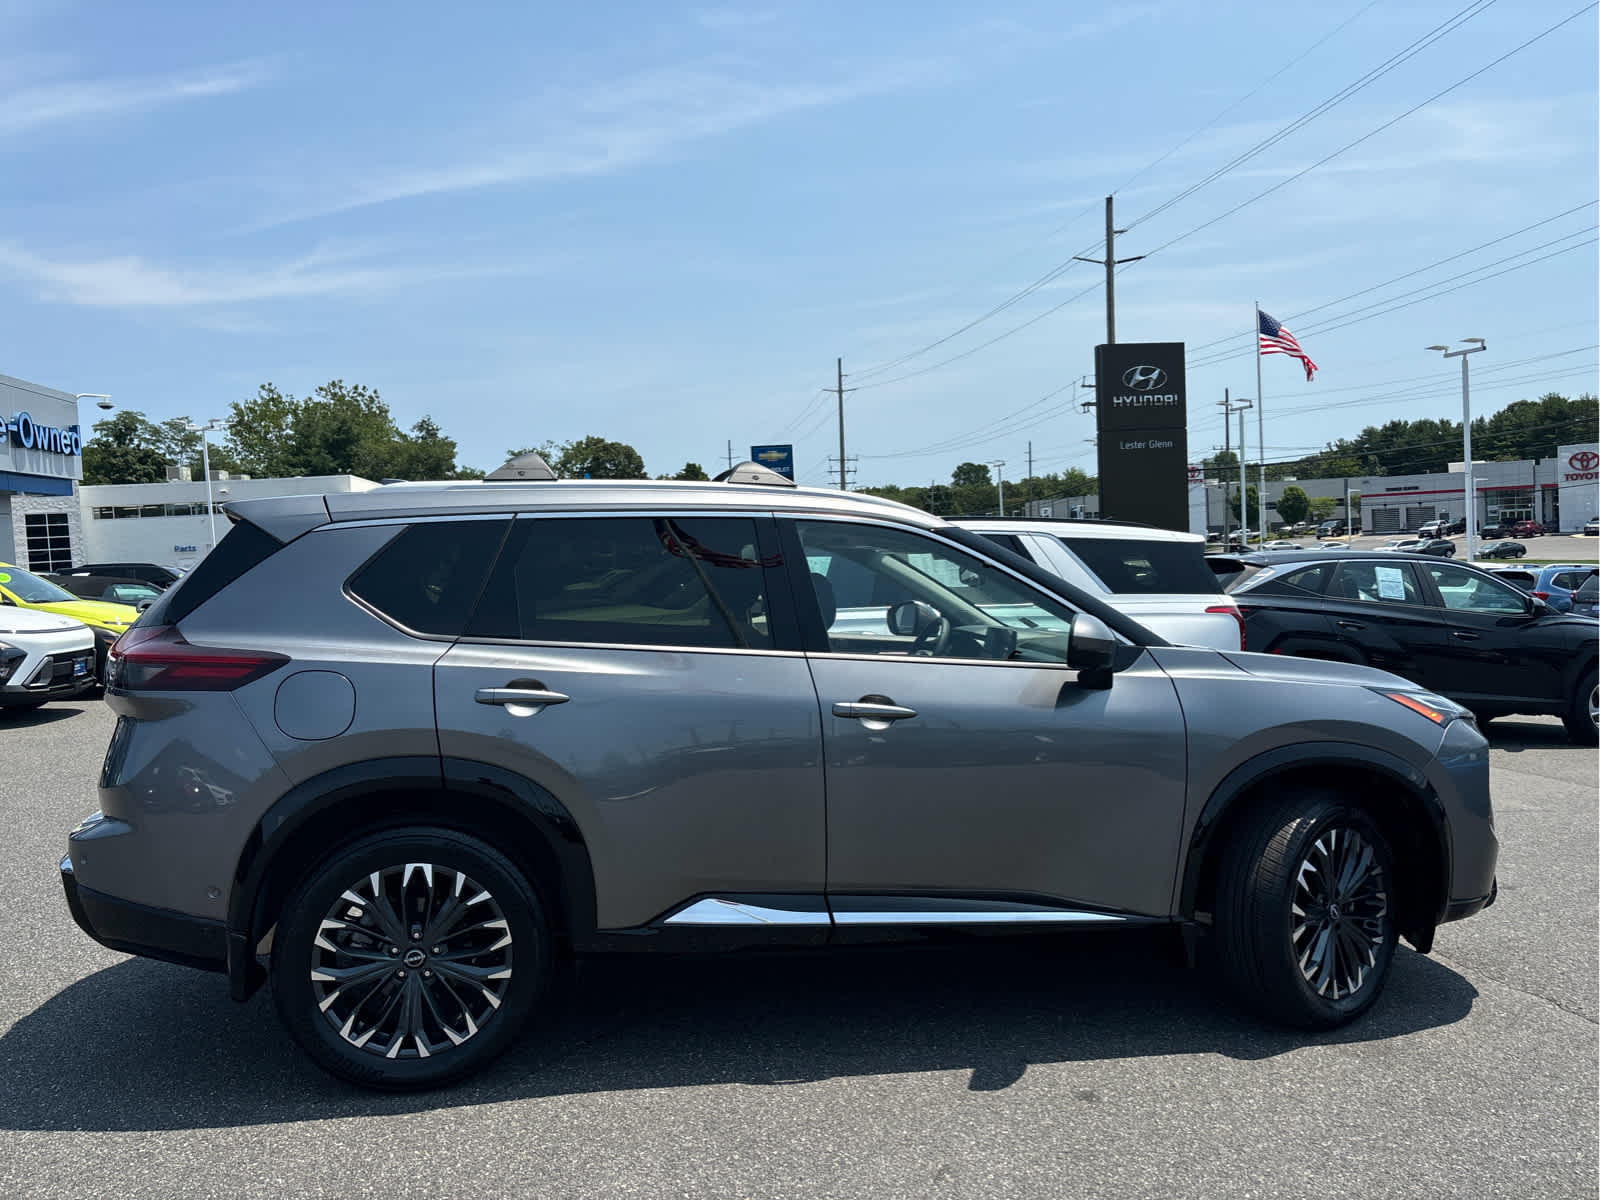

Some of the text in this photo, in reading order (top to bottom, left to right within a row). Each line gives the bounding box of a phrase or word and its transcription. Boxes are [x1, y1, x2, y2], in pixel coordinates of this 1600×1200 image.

[1113, 393, 1178, 407] HYUNDAI
[1120, 439, 1173, 450] Lester Glenn
